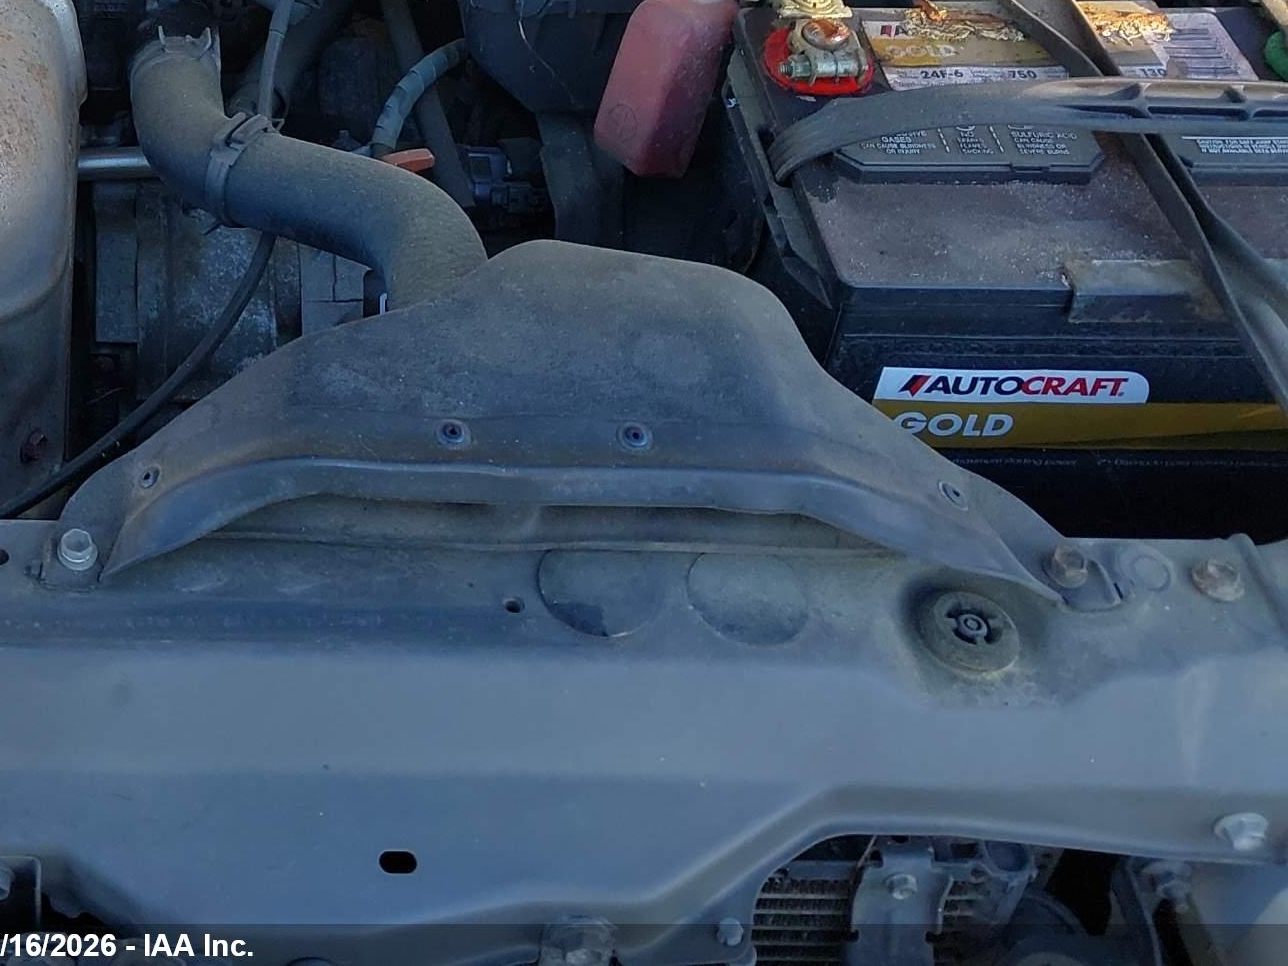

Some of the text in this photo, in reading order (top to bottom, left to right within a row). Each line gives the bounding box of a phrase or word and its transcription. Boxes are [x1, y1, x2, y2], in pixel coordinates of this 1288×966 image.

[887, 44, 955, 58] GOLD
[920, 70, 964, 80] 24F-6
[1008, 70, 1037, 79] 750
[924, 375, 1129, 396] AUTOCRAFT
[894, 411, 1014, 438] GOLD
